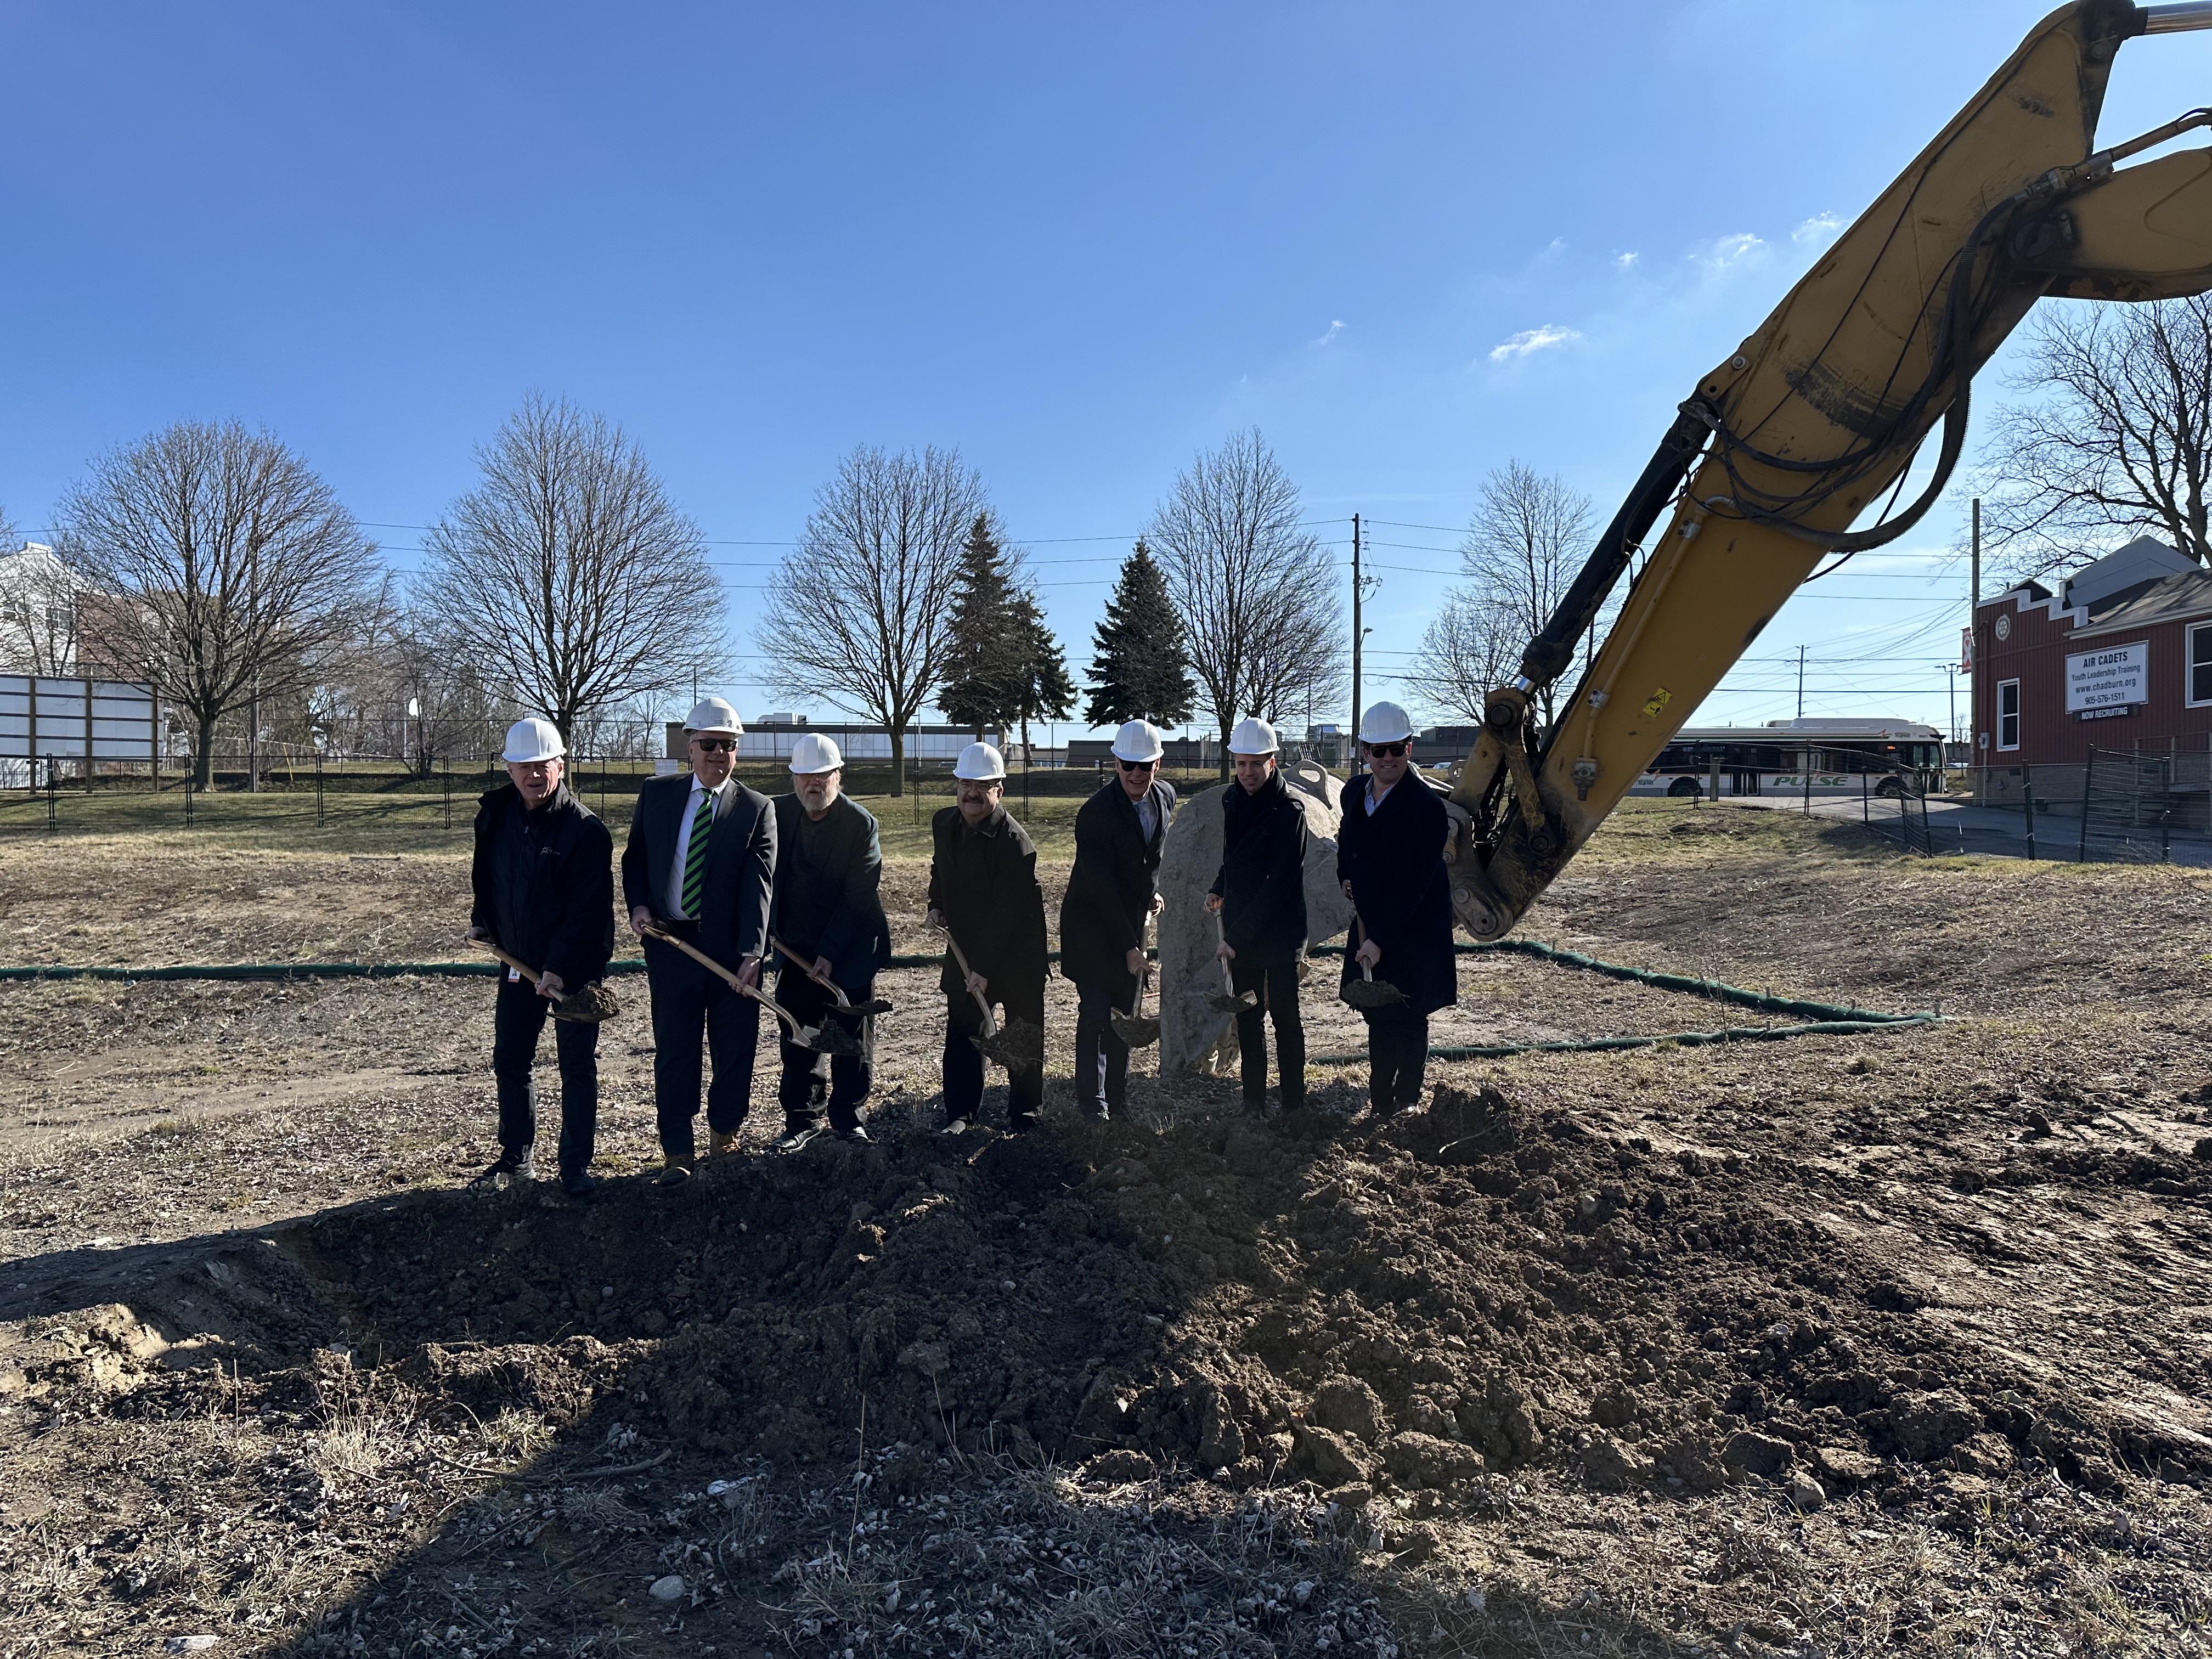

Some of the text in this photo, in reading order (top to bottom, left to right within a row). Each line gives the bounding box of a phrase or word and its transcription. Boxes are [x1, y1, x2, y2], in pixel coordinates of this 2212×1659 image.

[2084, 651, 2128, 668] AIR CADETS
[2072, 664, 2141, 681] Youth Leadership Training
[2075, 678, 2136, 693] www.chadburn.org
[2085, 692, 2124, 705] 905-576-1511
[2081, 707, 2128, 720] NOW RECRUITING
[1773, 776, 1848, 786] PULSE
